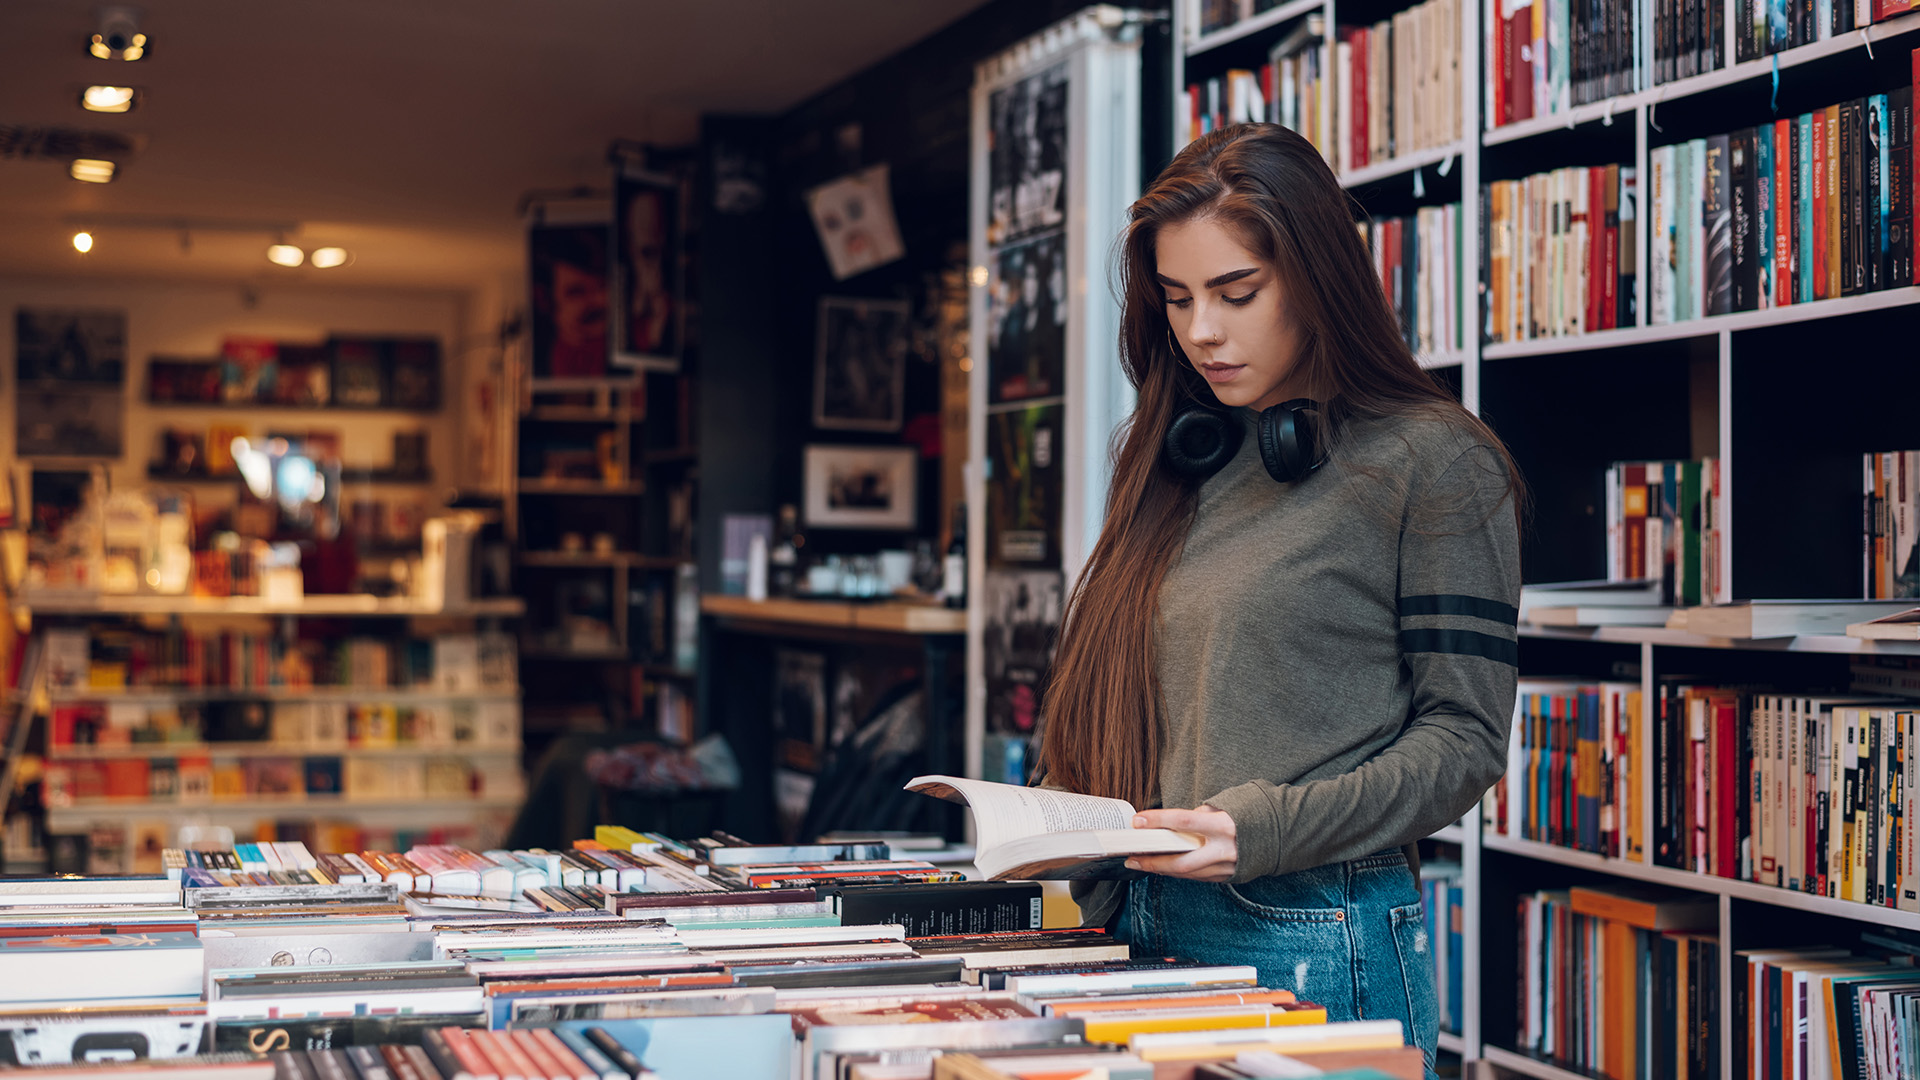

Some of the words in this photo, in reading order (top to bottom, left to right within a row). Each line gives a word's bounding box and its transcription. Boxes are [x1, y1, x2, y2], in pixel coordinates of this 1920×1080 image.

[1801, 123, 1809, 162] Irving
[1813, 122, 1822, 161] Irving
[1827, 118, 1837, 157] Irving
[1855, 1023, 1863, 1048] LUNDE
